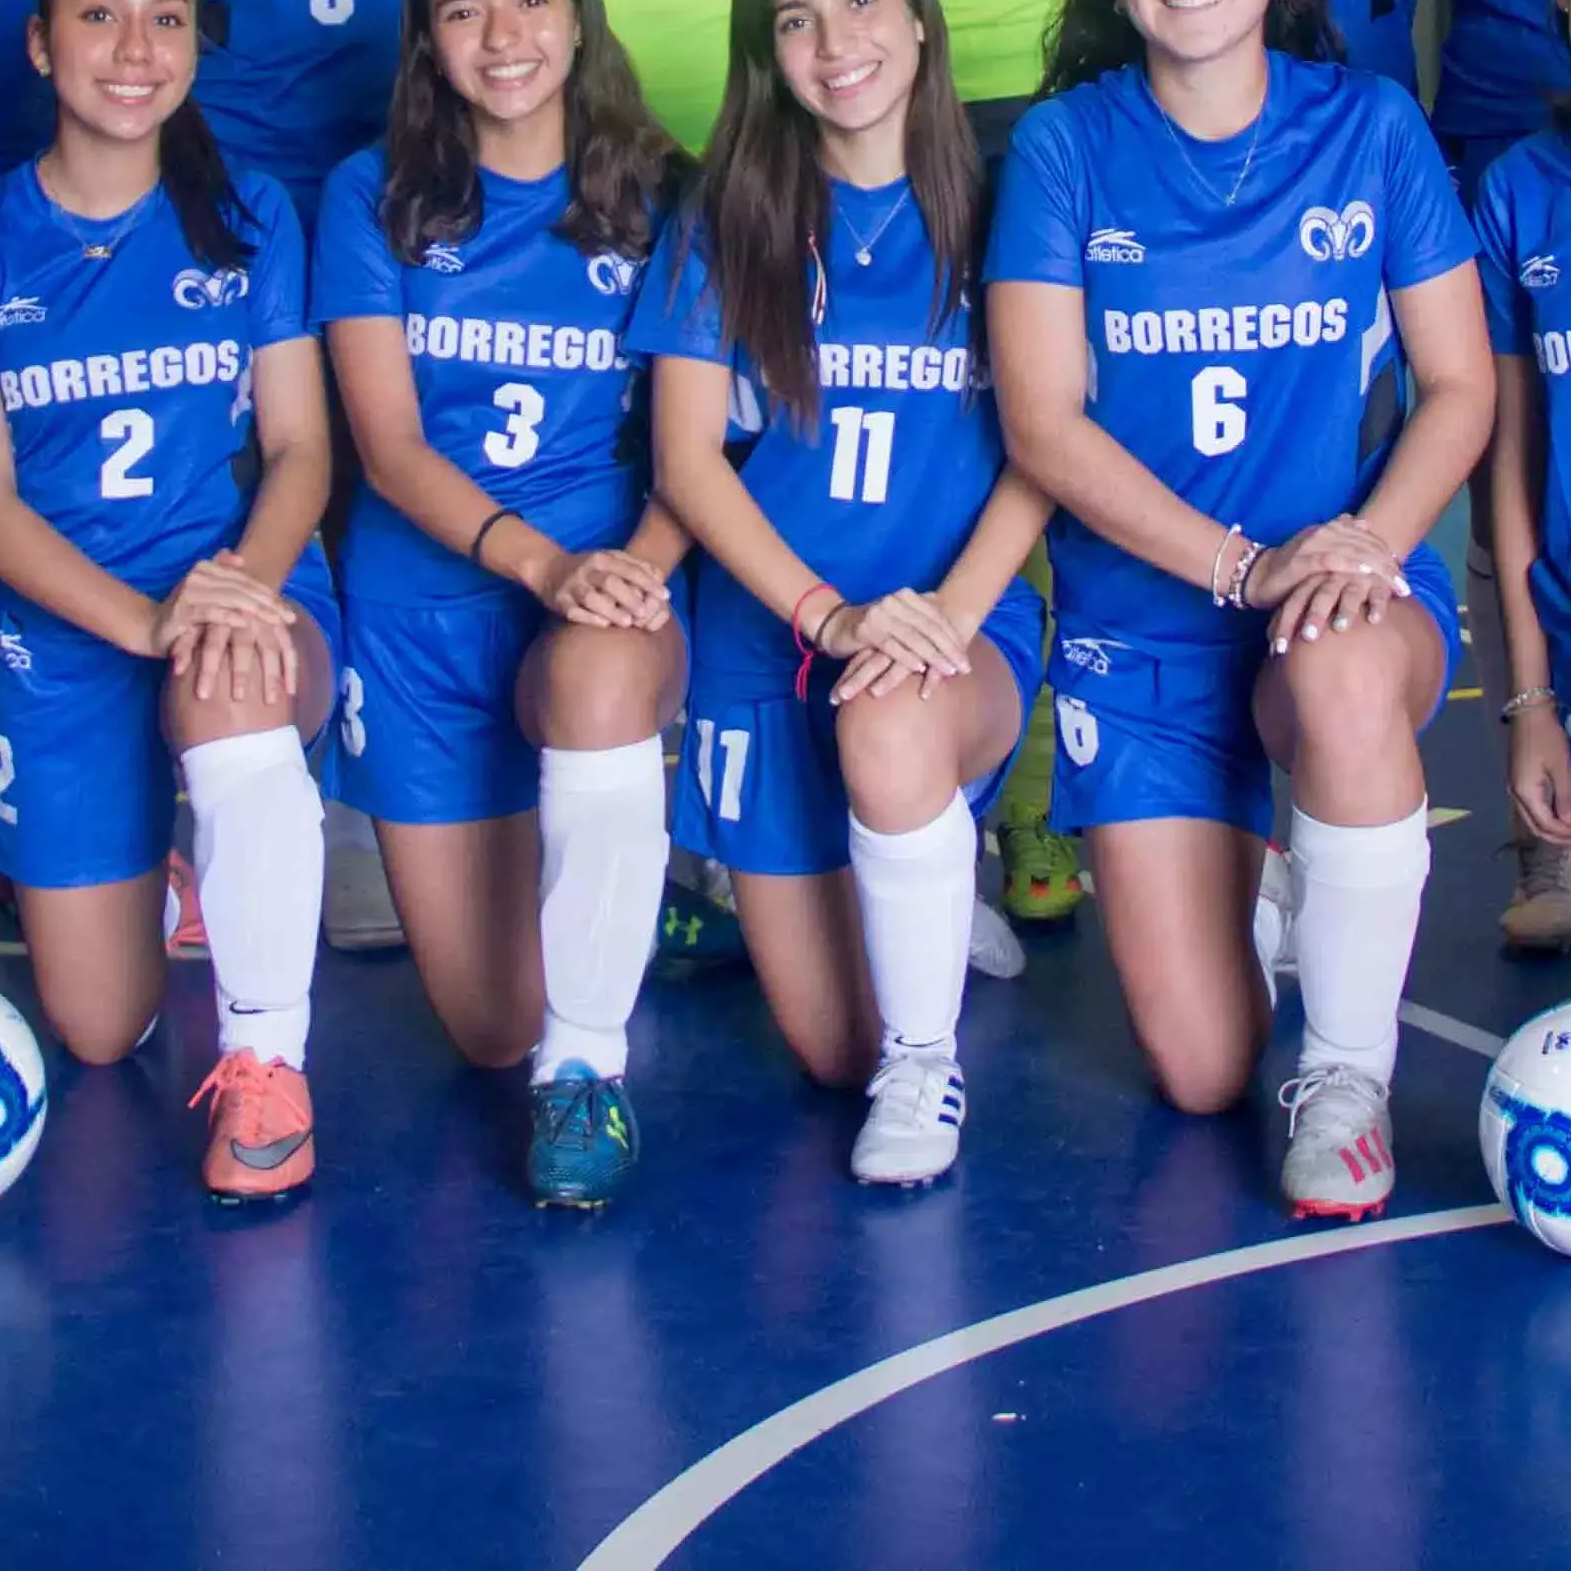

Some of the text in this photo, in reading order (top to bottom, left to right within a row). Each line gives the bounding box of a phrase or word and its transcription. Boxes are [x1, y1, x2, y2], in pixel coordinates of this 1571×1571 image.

[407, 313, 628, 371] BORREGO
[818, 343, 977, 392] RREGO
[1104, 298, 1348, 355] BORREGOS
[0, 340, 240, 412] BORREGOS
[1190, 366, 1248, 457] 6
[100, 408, 155, 499] 2
[484, 382, 545, 468] 3
[829, 406, 896, 505] 11
[697, 719, 750, 822] 11
